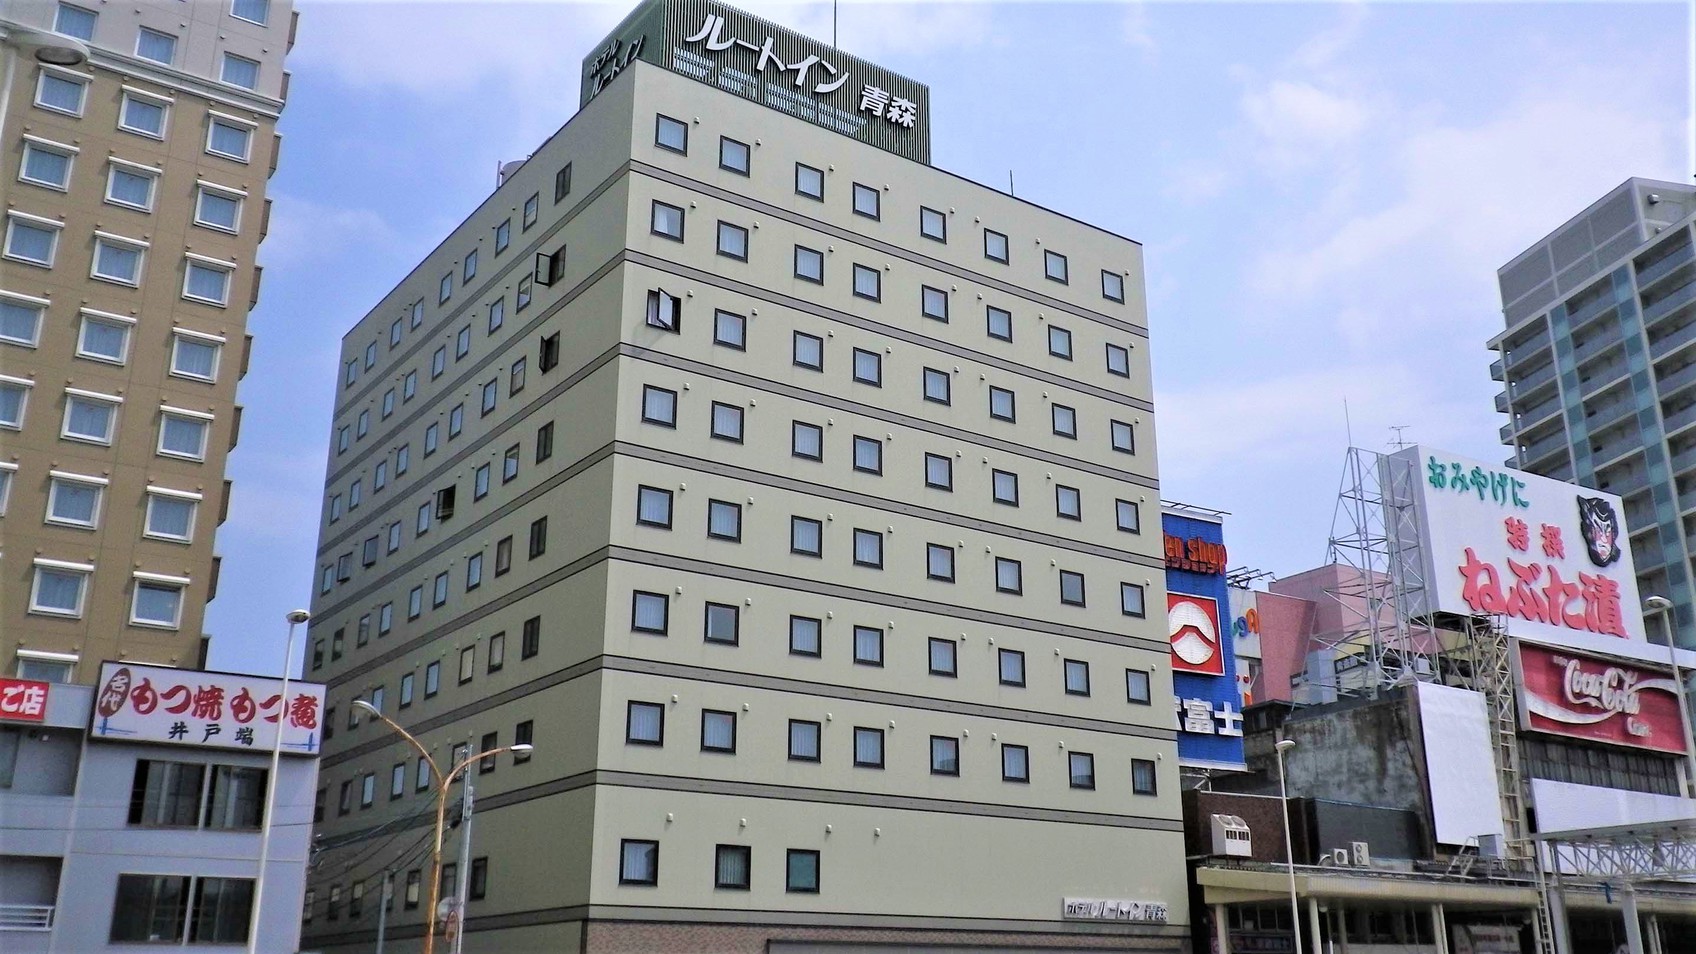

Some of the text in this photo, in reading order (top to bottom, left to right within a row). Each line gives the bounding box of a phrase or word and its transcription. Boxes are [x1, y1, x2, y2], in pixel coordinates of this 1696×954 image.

[589, 34, 645, 100] ルートイン
[590, 39, 621, 75] ホテル
[685, 13, 917, 129] ルートイン 青森
[1428, 456, 1530, 508] おみやげに
[1459, 547, 1630, 639] ねぶた漬
[100, 675, 128, 711] 名代
[131, 678, 224, 720] もつ焼
[1564, 659, 1640, 715] Coca-Cola
[168, 721, 254, 746] 井戸端
